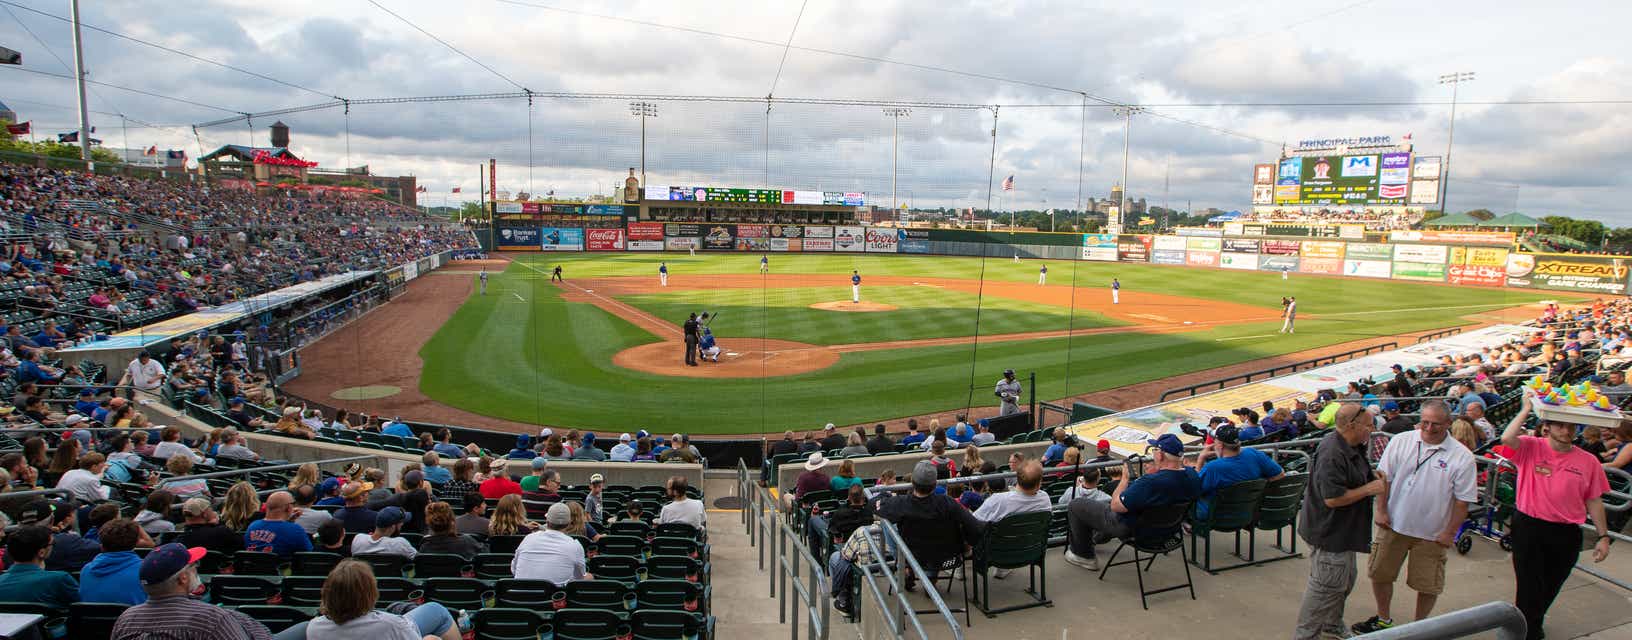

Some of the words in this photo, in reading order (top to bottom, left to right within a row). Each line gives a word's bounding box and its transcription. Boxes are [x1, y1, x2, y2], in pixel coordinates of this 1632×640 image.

[1299, 138, 1357, 148] PRINCIPAL
[1359, 136, 1391, 145] PARK
[250, 150, 320, 168] Budweiser
[866, 230, 897, 243] Coors
